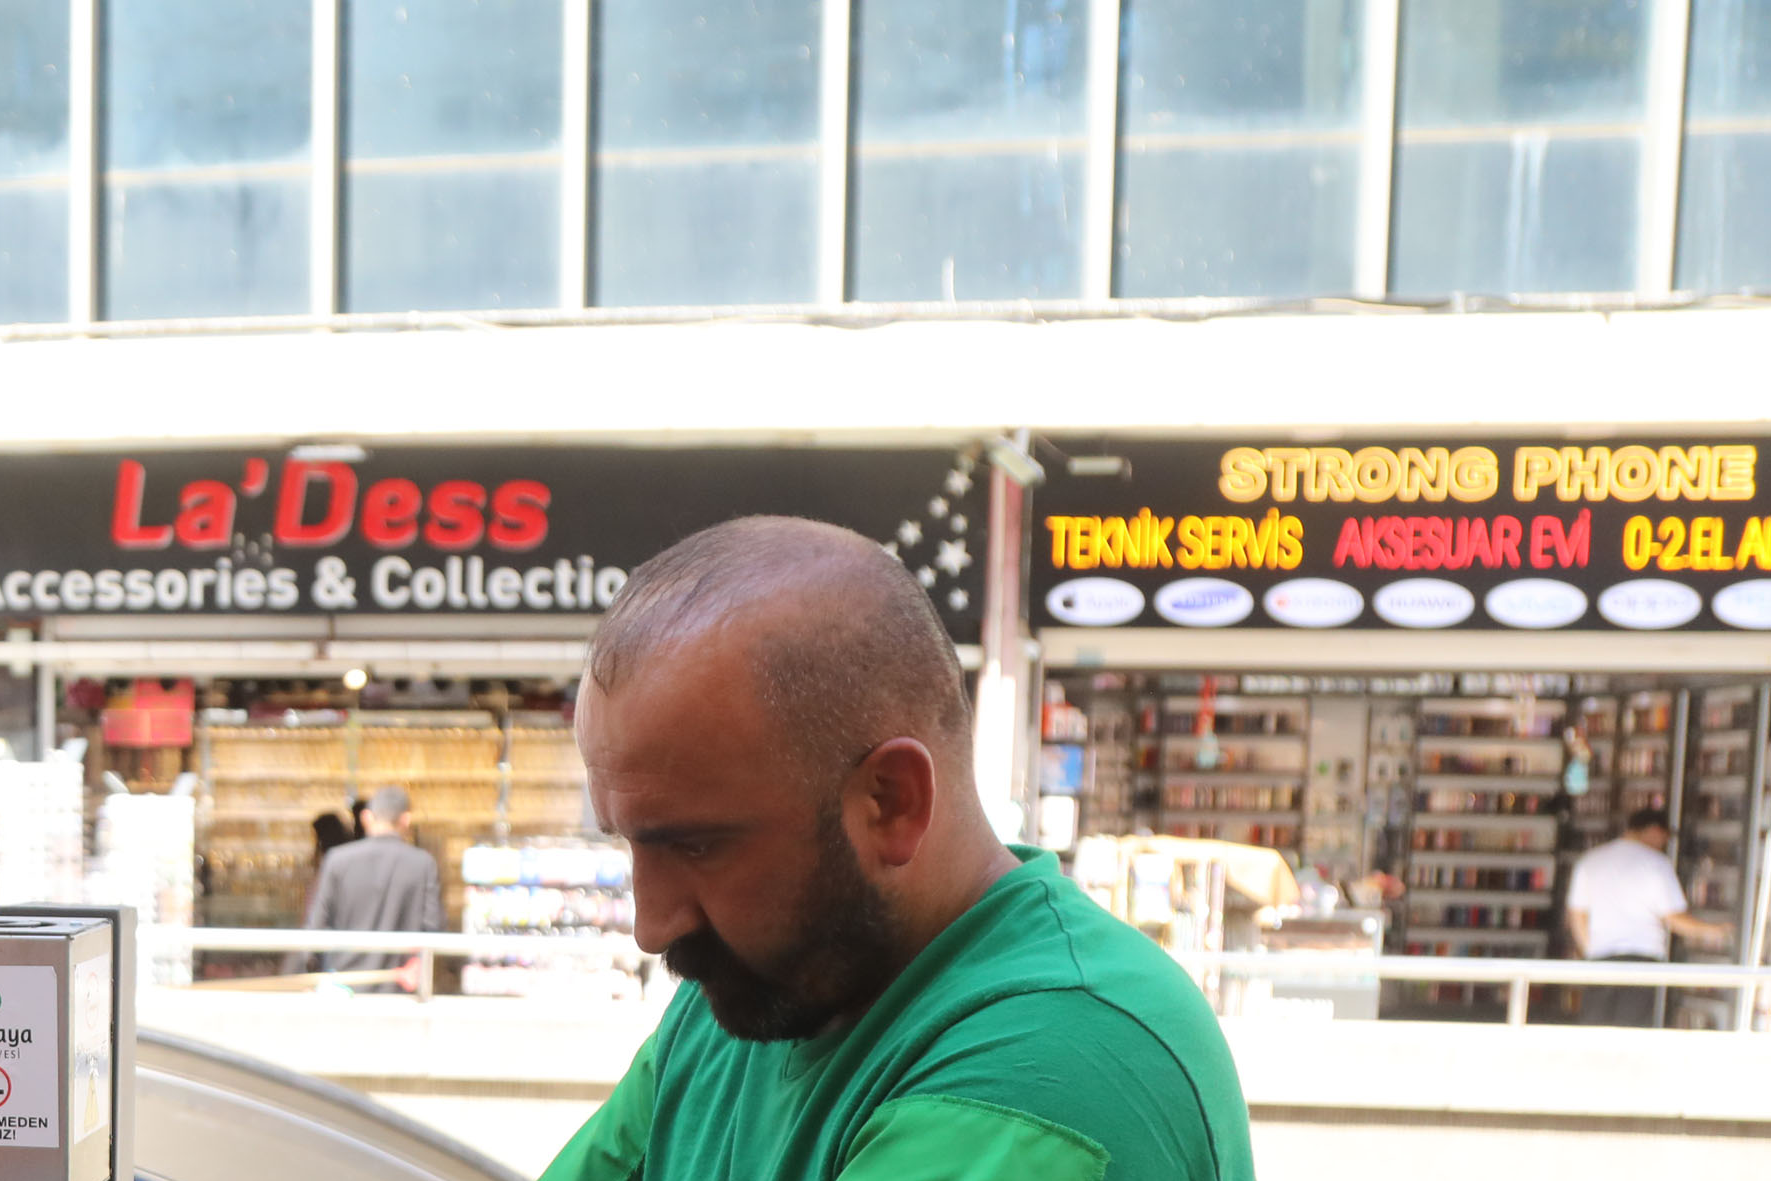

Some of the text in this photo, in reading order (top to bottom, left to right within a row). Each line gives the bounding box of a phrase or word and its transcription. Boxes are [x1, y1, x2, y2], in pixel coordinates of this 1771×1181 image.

[111, 457, 551, 549] La'Dess
[1218, 445, 1756, 503] STRONG PHONE
[1044, 506, 1592, 571] TEKNİK SERVİS AKSESUAR EVİ
[1735, 516, 1771, 572] A
[312, 556, 357, 609] &
[370, 556, 629, 609] Collectio
